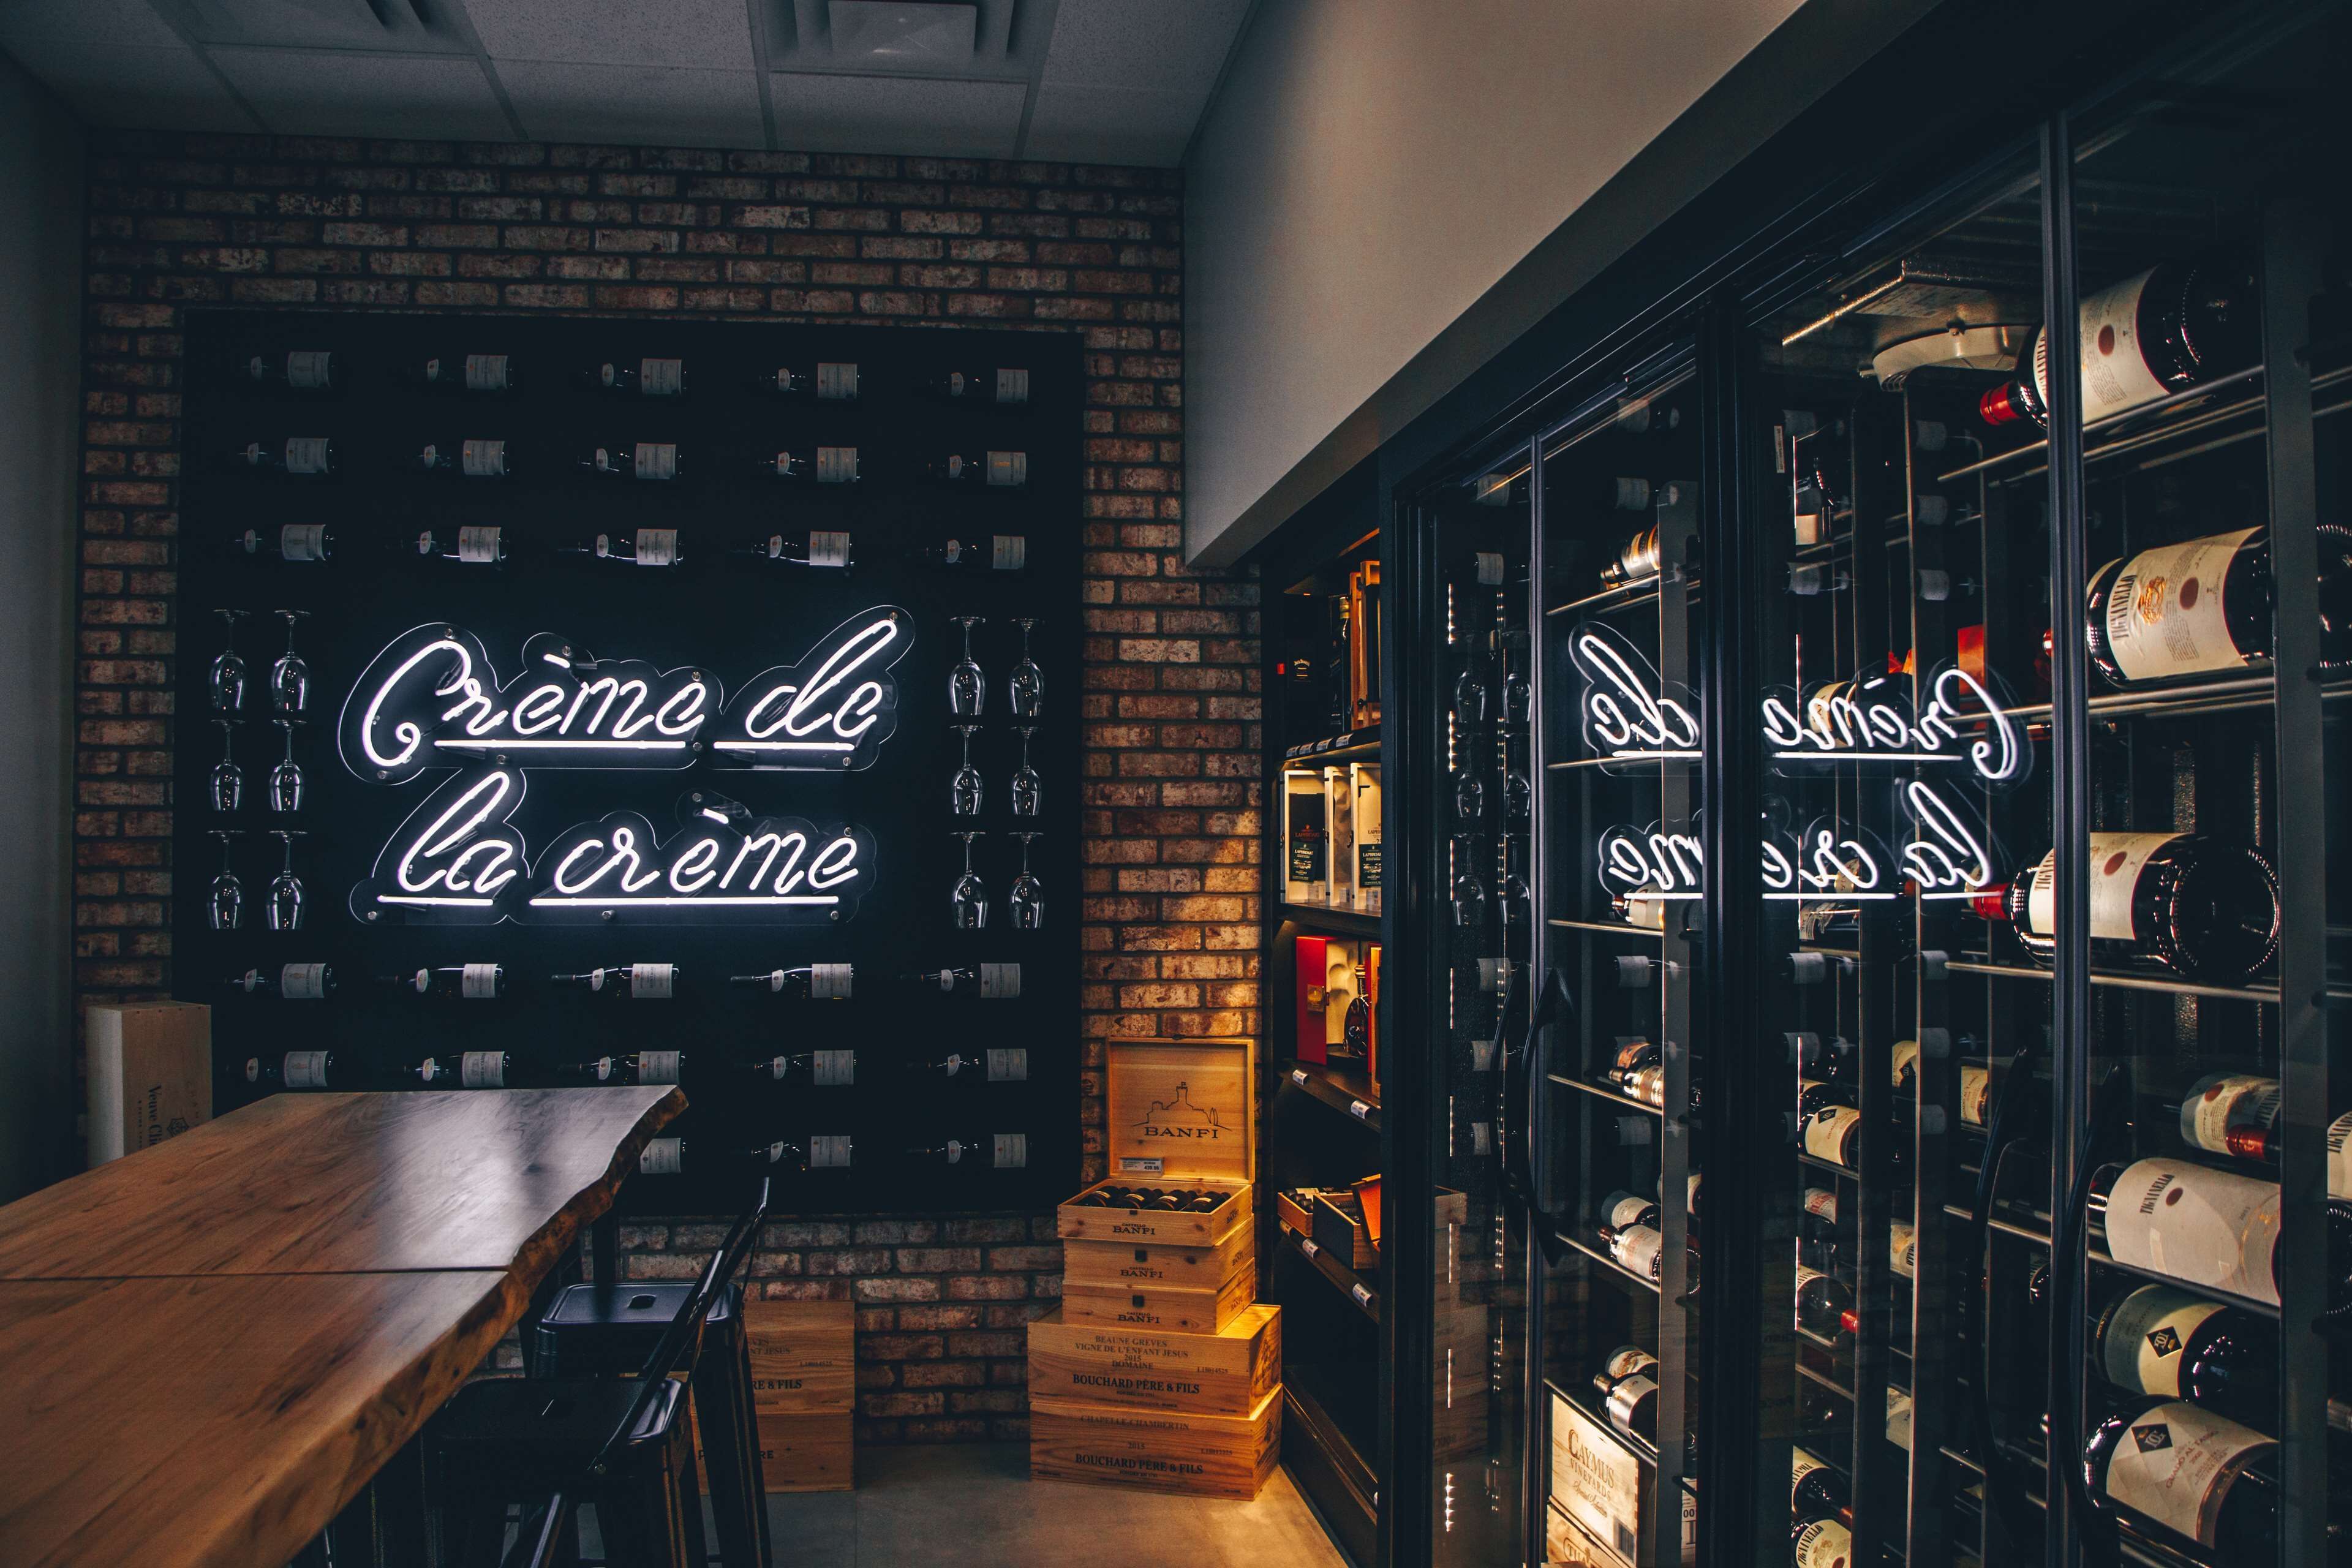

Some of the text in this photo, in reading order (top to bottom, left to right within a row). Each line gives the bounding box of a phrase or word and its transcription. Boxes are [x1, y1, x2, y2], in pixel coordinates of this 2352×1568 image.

[2111, 575, 2137, 640] TIGNANELLO
[363, 620, 897, 766] Crème de
[399, 772, 858, 894] la crème
[148, 1083, 162, 1121] Veuve
[1145, 1126, 1218, 1139] BANFI
[2139, 1173, 2175, 1215] TIGNANELLO
[1113, 1226, 1155, 1235] BANFI
[1120, 1269, 1163, 1278] BANFI
[1118, 1314, 1160, 1324] BANFI
[1075, 1343, 1102, 1352] VIGNE
[1112, 1360, 1153, 1370] DOMAINE
[767, 1381, 774, 1389] &
[777, 1379, 803, 1389] FILS
[1073, 1374, 1200, 1394] BOUCHARD PÈRE & FILS
[1076, 1453, 1203, 1474] BOUCHARD PÈRE & FILS
[1568, 1429, 1614, 1489] CAYMUS
[1570, 1458, 1611, 1501] VINEYARDS
[1797, 1524, 1824, 1566] TIGNANELLO
